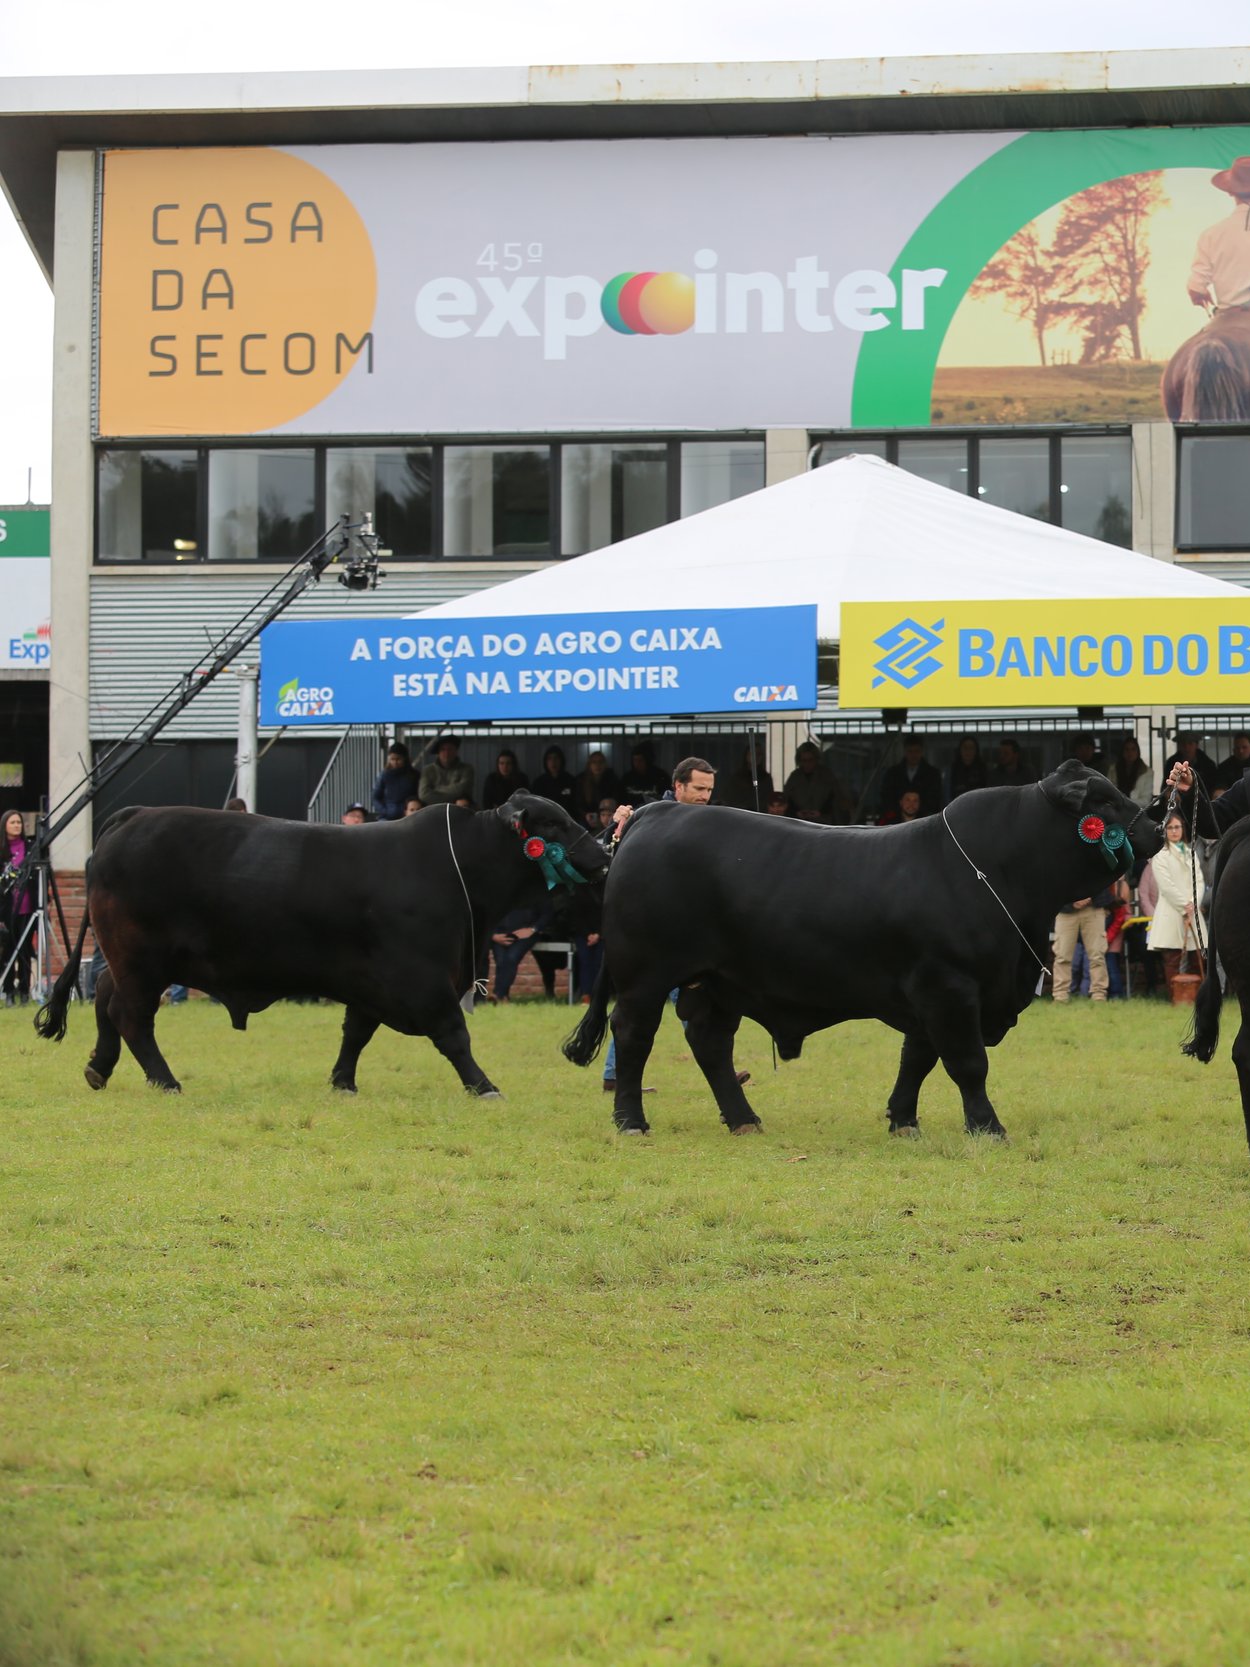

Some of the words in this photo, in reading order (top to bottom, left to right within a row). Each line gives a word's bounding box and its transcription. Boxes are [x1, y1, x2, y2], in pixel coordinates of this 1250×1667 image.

[152, 202, 323, 245] CASA
[151, 269, 235, 311] DA
[415, 249, 948, 360] expointer
[149, 332, 374, 377] SECOM
[350, 638, 372, 661] A
[379, 635, 475, 665] FORÇA
[482, 633, 527, 657] DO
[534, 631, 622, 656] AGRO
[629, 627, 722, 653] CAIXA
[958, 627, 1133, 678] BANCO
[1143, 634, 1208, 676] DO
[285, 687, 334, 702] AGRO
[393, 665, 459, 697] ESTÁ
[466, 671, 511, 695] NA
[518, 666, 680, 693] EXPOINTER
[733, 685, 798, 703] CAIXA
[279, 701, 334, 717] CAIXA
